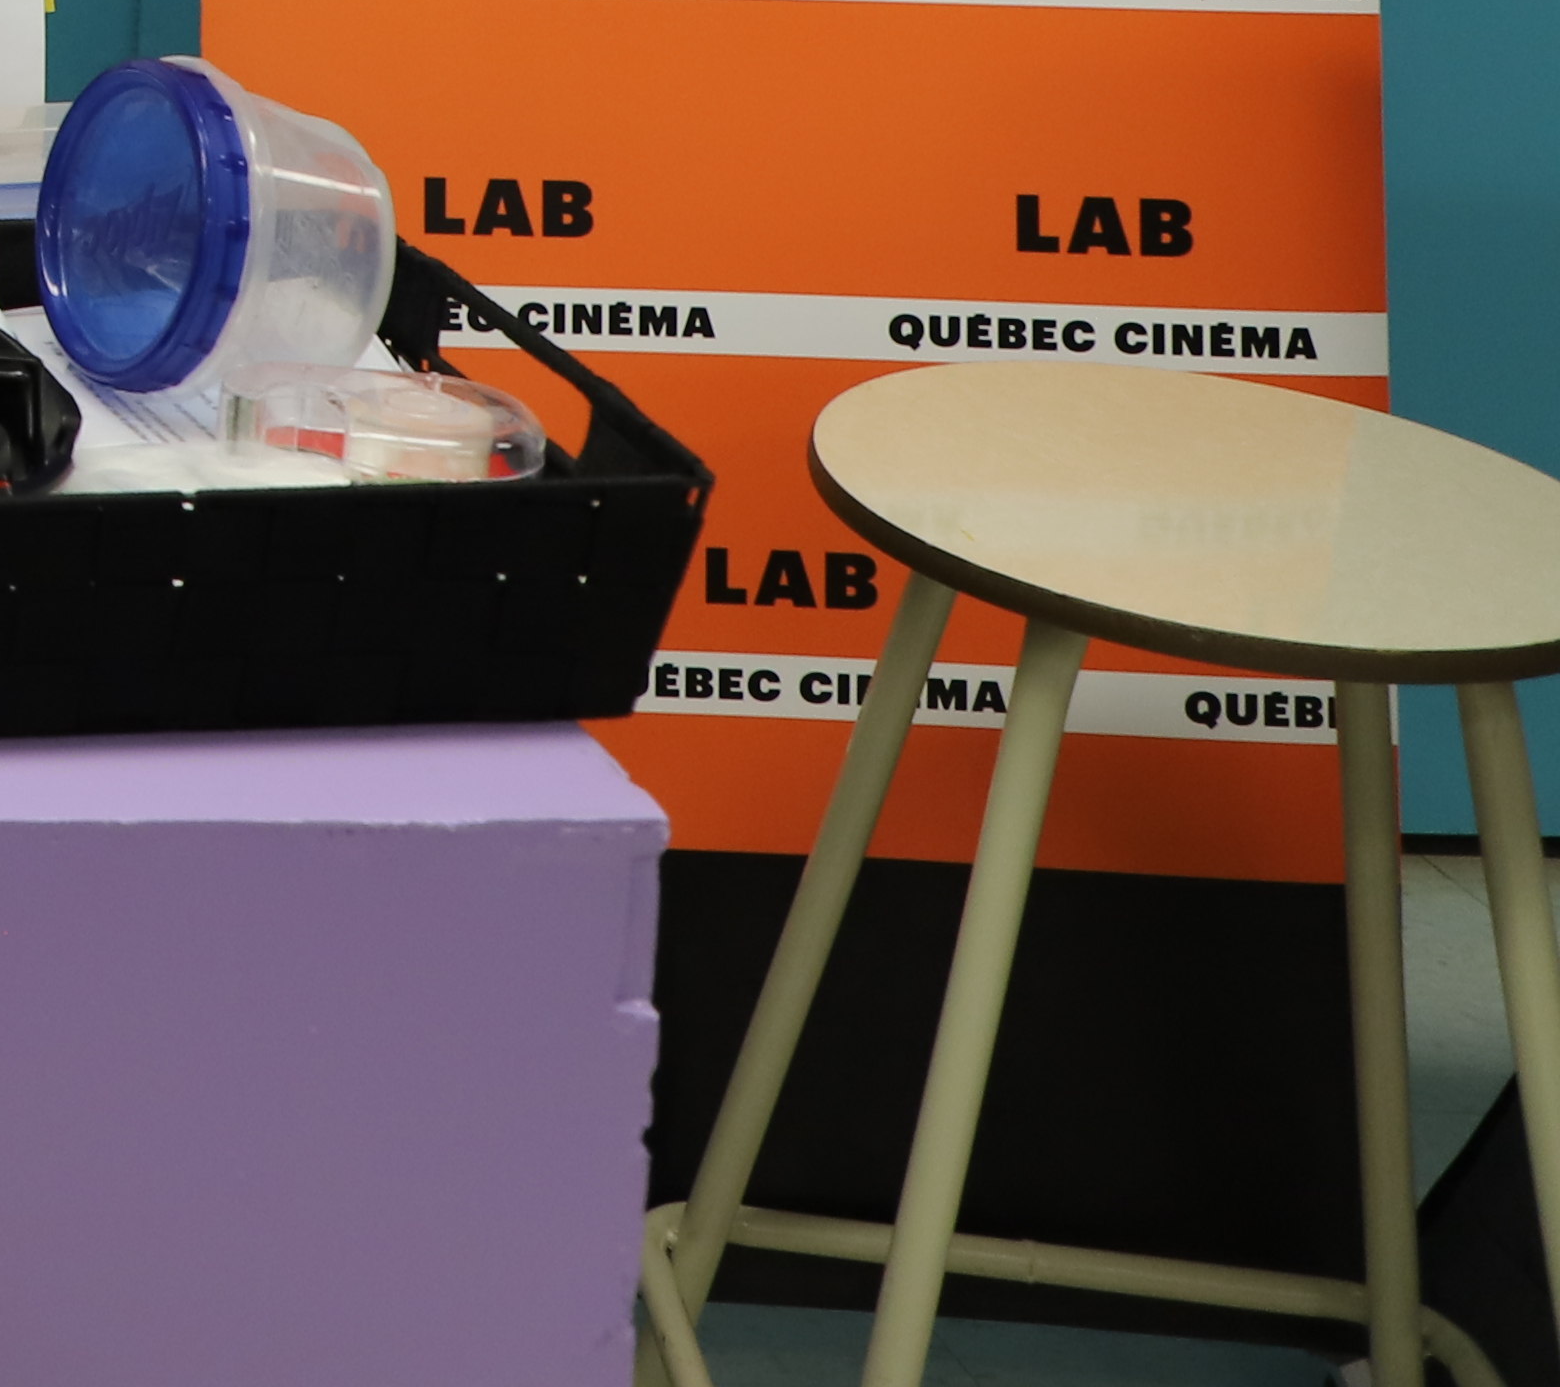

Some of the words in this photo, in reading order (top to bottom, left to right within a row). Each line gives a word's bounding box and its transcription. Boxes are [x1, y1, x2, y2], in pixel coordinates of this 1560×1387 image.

[425, 176, 593, 237] LAB
[1017, 193, 1193, 257] LAB
[517, 301, 715, 340] CINÉMA
[889, 312, 1095, 353] QUÉBEC
[1114, 321, 1317, 360] CINÉMA
[706, 548, 877, 612] LAB
[655, 663, 781, 703] ÉBEC
[799, 671, 1009, 715] CIMA
[1184, 690, 1337, 730] QUÉB
